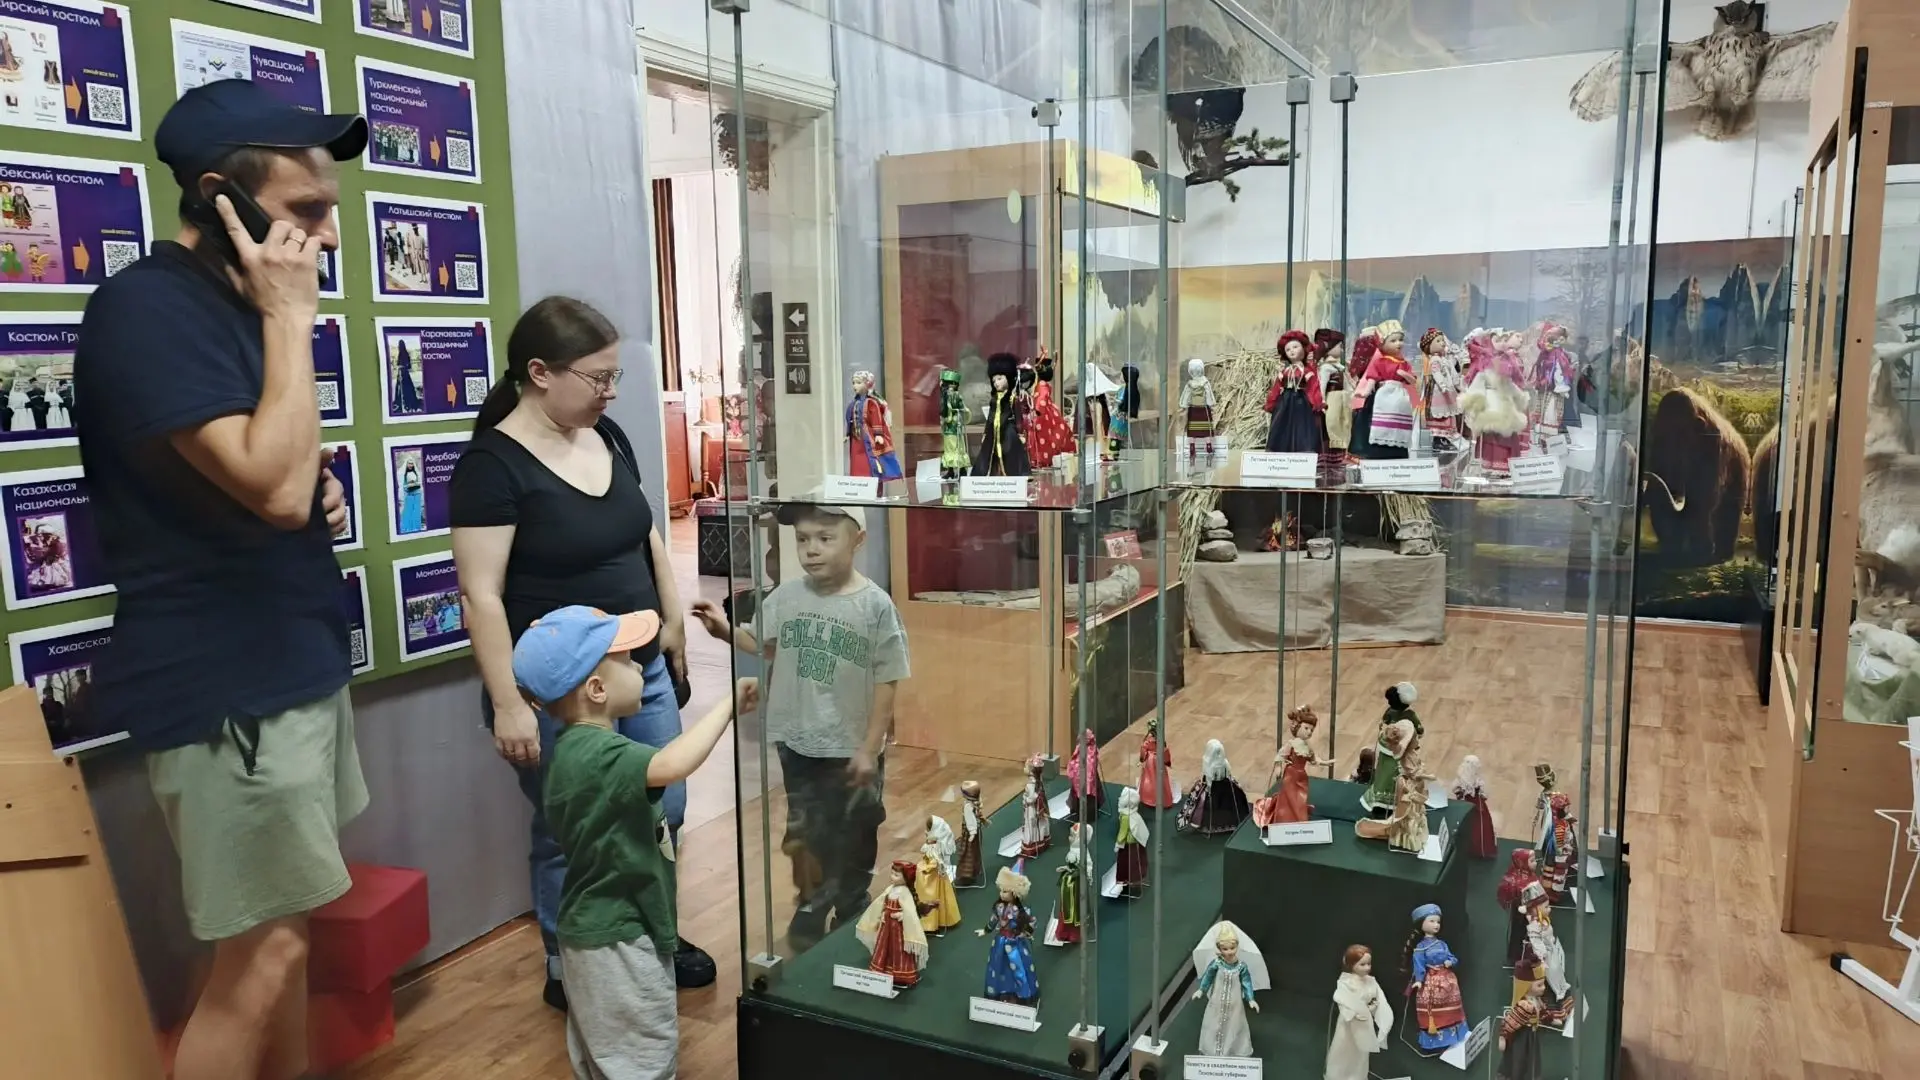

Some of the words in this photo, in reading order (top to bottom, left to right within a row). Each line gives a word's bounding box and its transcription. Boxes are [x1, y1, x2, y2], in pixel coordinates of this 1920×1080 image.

[52, 9, 101, 27] костюм
[252, 54, 305, 73] Чувашский
[256, 70, 294, 84] костюм
[368, 77, 422, 96] Туркменский
[370, 92, 428, 108] национальный
[371, 103, 403, 115] костюм
[56, 173, 104, 186] костюм
[388, 206, 433, 218] Латышский
[433, 212, 463, 221] костюм
[8, 331, 59, 342] Костюм
[420, 329, 473, 339] Карачаевский
[421, 340, 469, 350] праздничный
[13, 483, 77, 497] Казахская
[15, 495, 90, 512] национальн
[48, 636, 111, 656] Хакасская
[780, 618, 870, 669] COLLEGE
